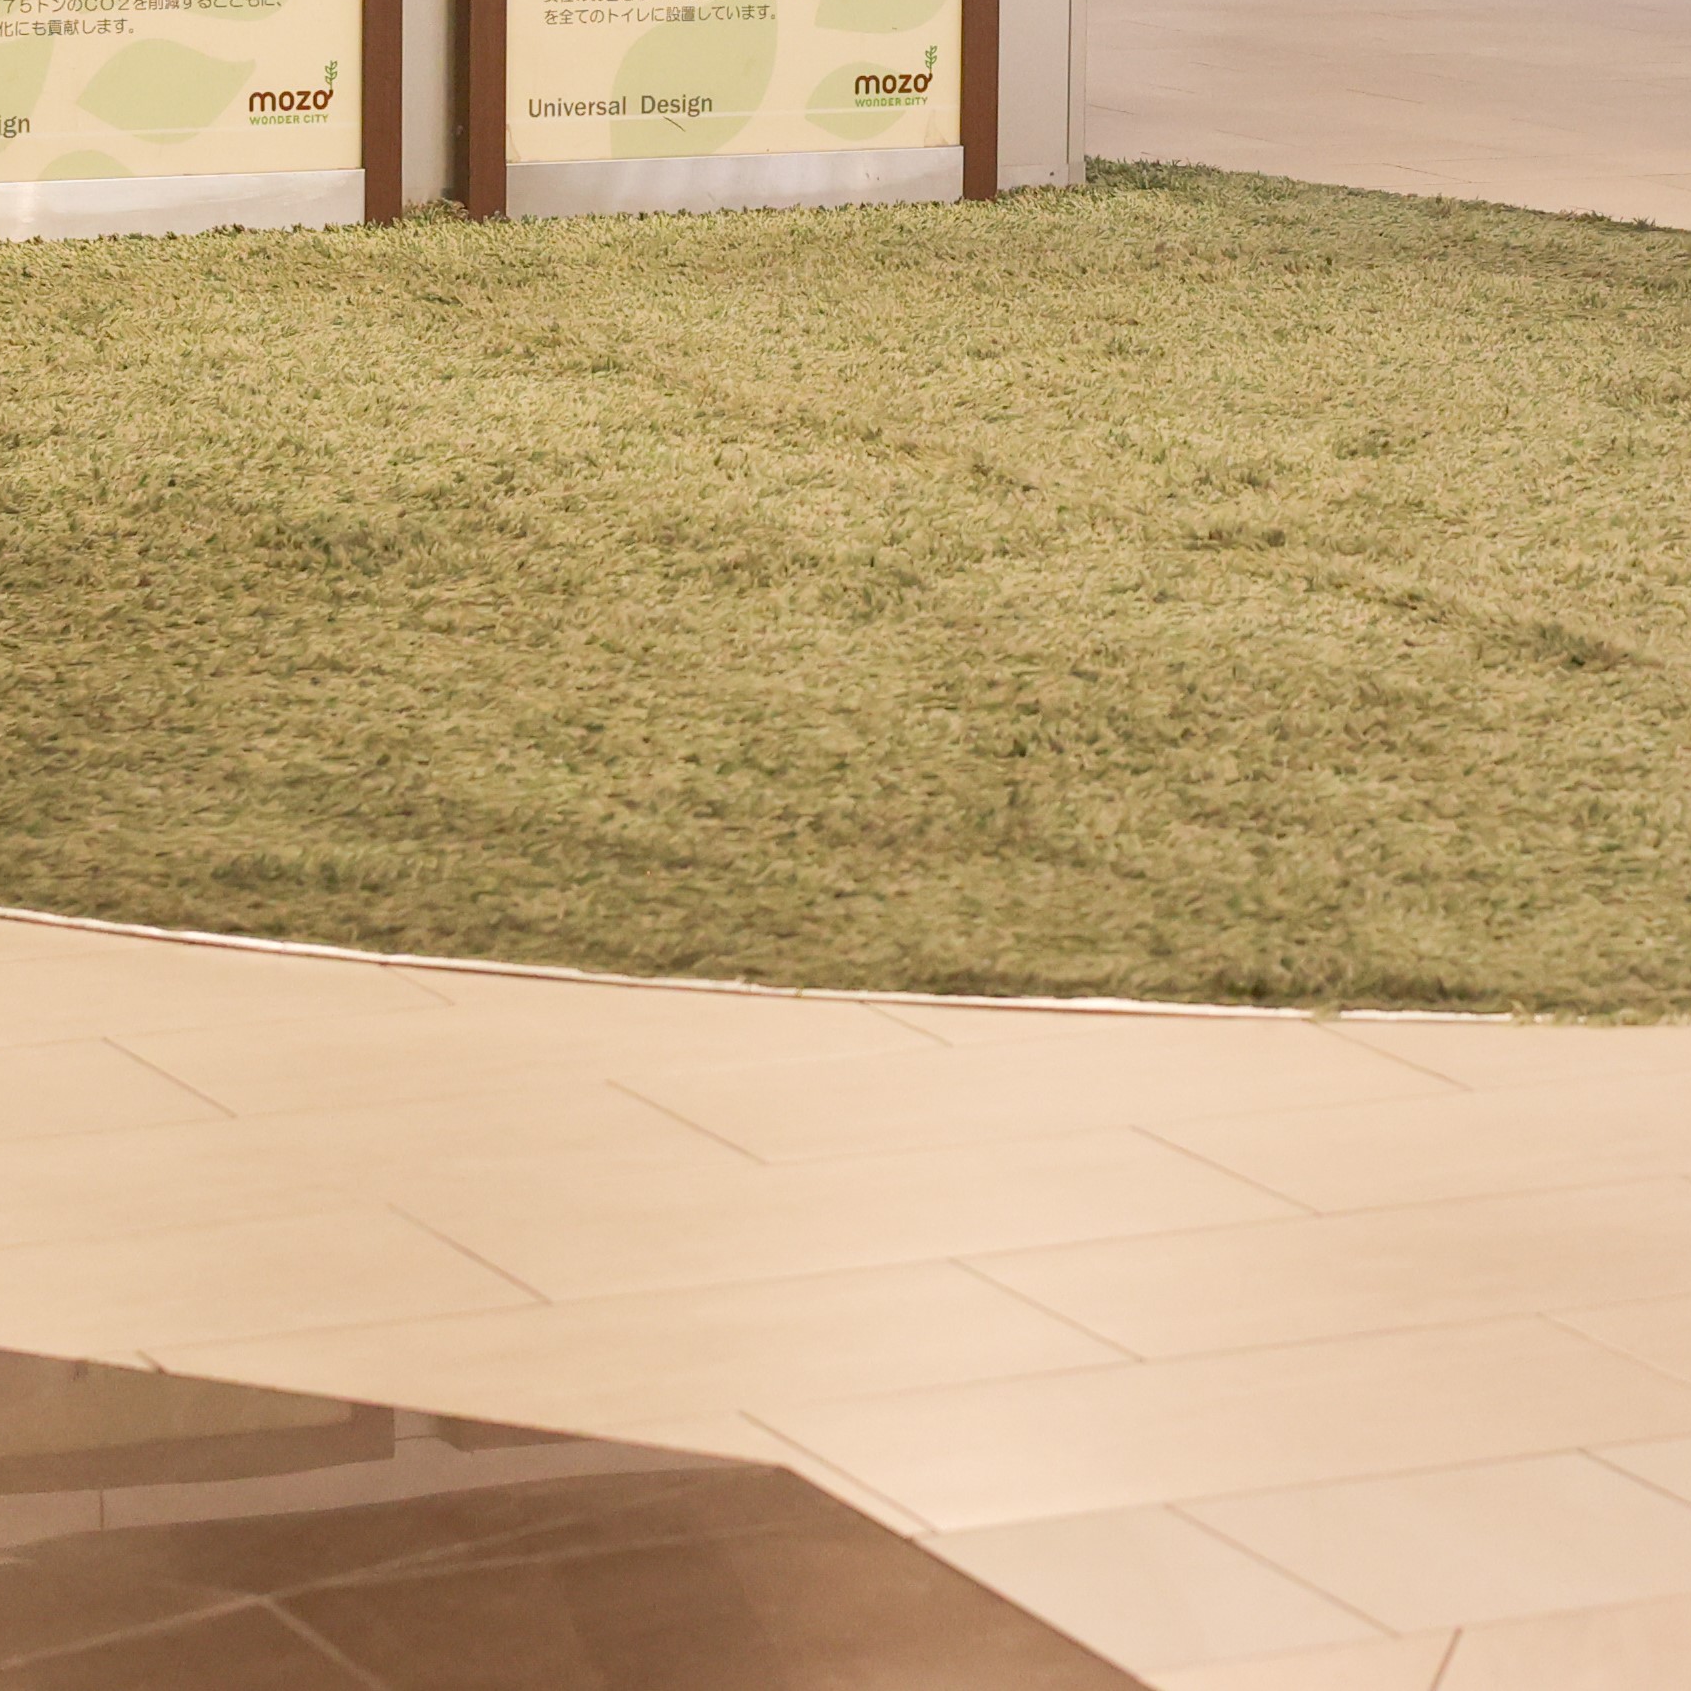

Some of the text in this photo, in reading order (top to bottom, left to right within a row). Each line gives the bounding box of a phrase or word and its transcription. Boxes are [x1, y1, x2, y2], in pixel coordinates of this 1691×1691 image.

[542, 3, 778, 26] を全てのトイレに設置しています。
[854, 73, 933, 96] mozo
[248, 89, 334, 112] mozo
[528, 94, 714, 119] Universal Design
[904, 95, 929, 107] CITY
[303, 114, 329, 124] CITY
